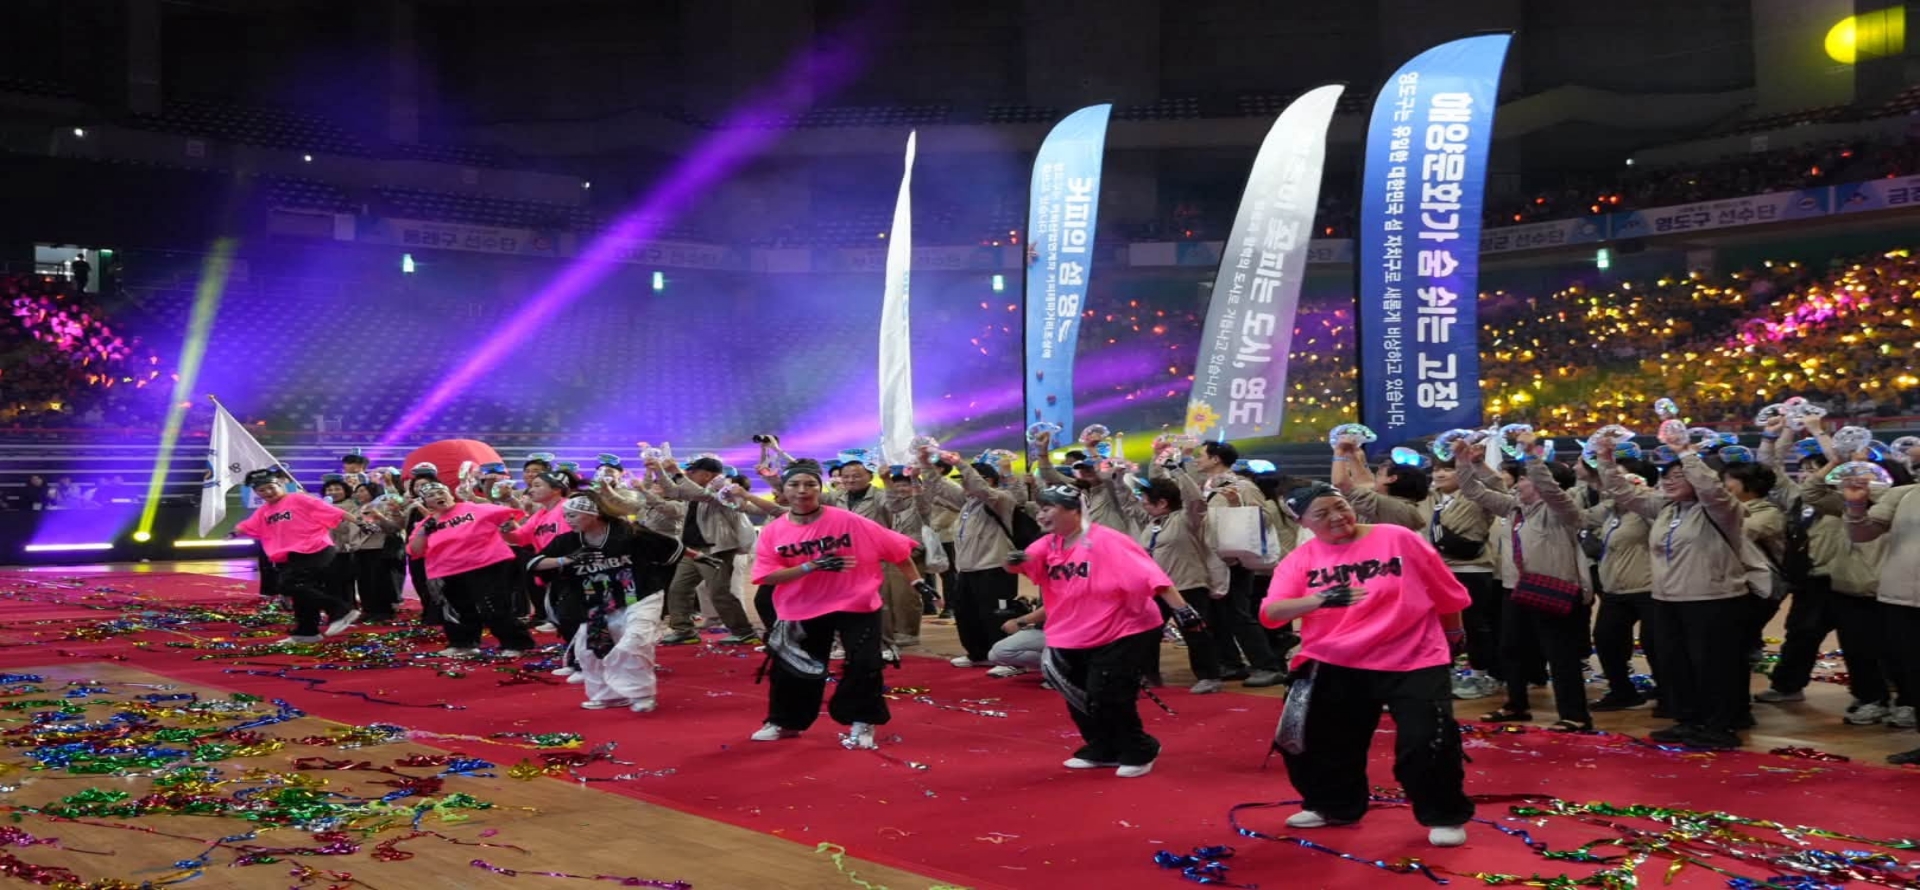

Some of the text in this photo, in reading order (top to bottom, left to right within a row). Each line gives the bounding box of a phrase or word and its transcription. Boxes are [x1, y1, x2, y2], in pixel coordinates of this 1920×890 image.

[1061, 177, 1095, 253] 커피의
[1654, 211, 1712, 232] 영도구
[1718, 204, 1777, 225] 선수단
[1250, 216, 1301, 303] 꽃피는
[1382, 72, 1419, 429] 영도구는 유일한 대한민국 섬 자치구로 새롭게 비상하고 있습니다.
[1417, 92, 1474, 411] 해양문화가 숨 쉬는 고장
[1059, 260, 1085, 287] 섬
[1227, 271, 1247, 305] 도시로
[1232, 309, 1276, 369] 도시,
[1228, 376, 1267, 425] 영도
[574, 554, 634, 576] ZUMBA
[776, 532, 853, 559] ZUMBA
[1306, 556, 1403, 588] ZUMBA
